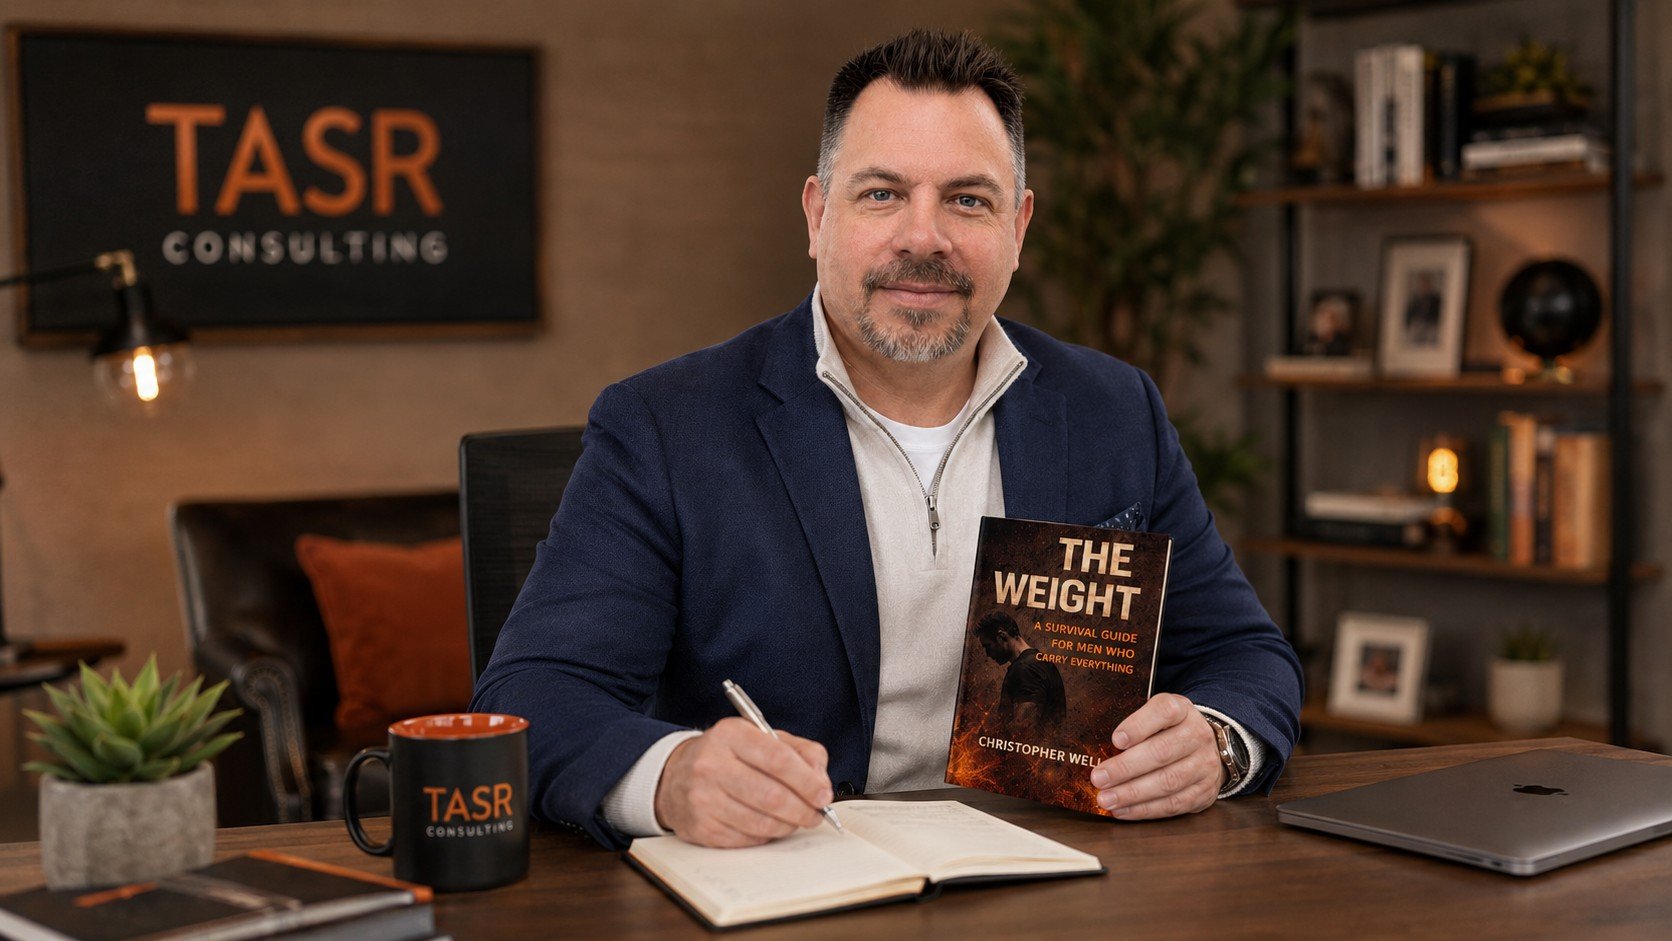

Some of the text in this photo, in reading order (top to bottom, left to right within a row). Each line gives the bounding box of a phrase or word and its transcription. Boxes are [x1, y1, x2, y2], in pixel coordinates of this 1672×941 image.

[145, 102, 443, 216] TASR
[162, 230, 449, 265] CONSULTING
[1059, 537, 1134, 578] THE
[994, 570, 1141, 621] WEIGHT
[1034, 621, 1138, 644] A SURVIVAL GUIDE
[1035, 652, 1134, 675] CARRY EVERYTHING
[1051, 639, 1135, 659] FOR MEN WHO
[978, 736, 1065, 762] CHRISTOPHER
[422, 782, 514, 823] TASR
[425, 820, 514, 838] CONSULTING
